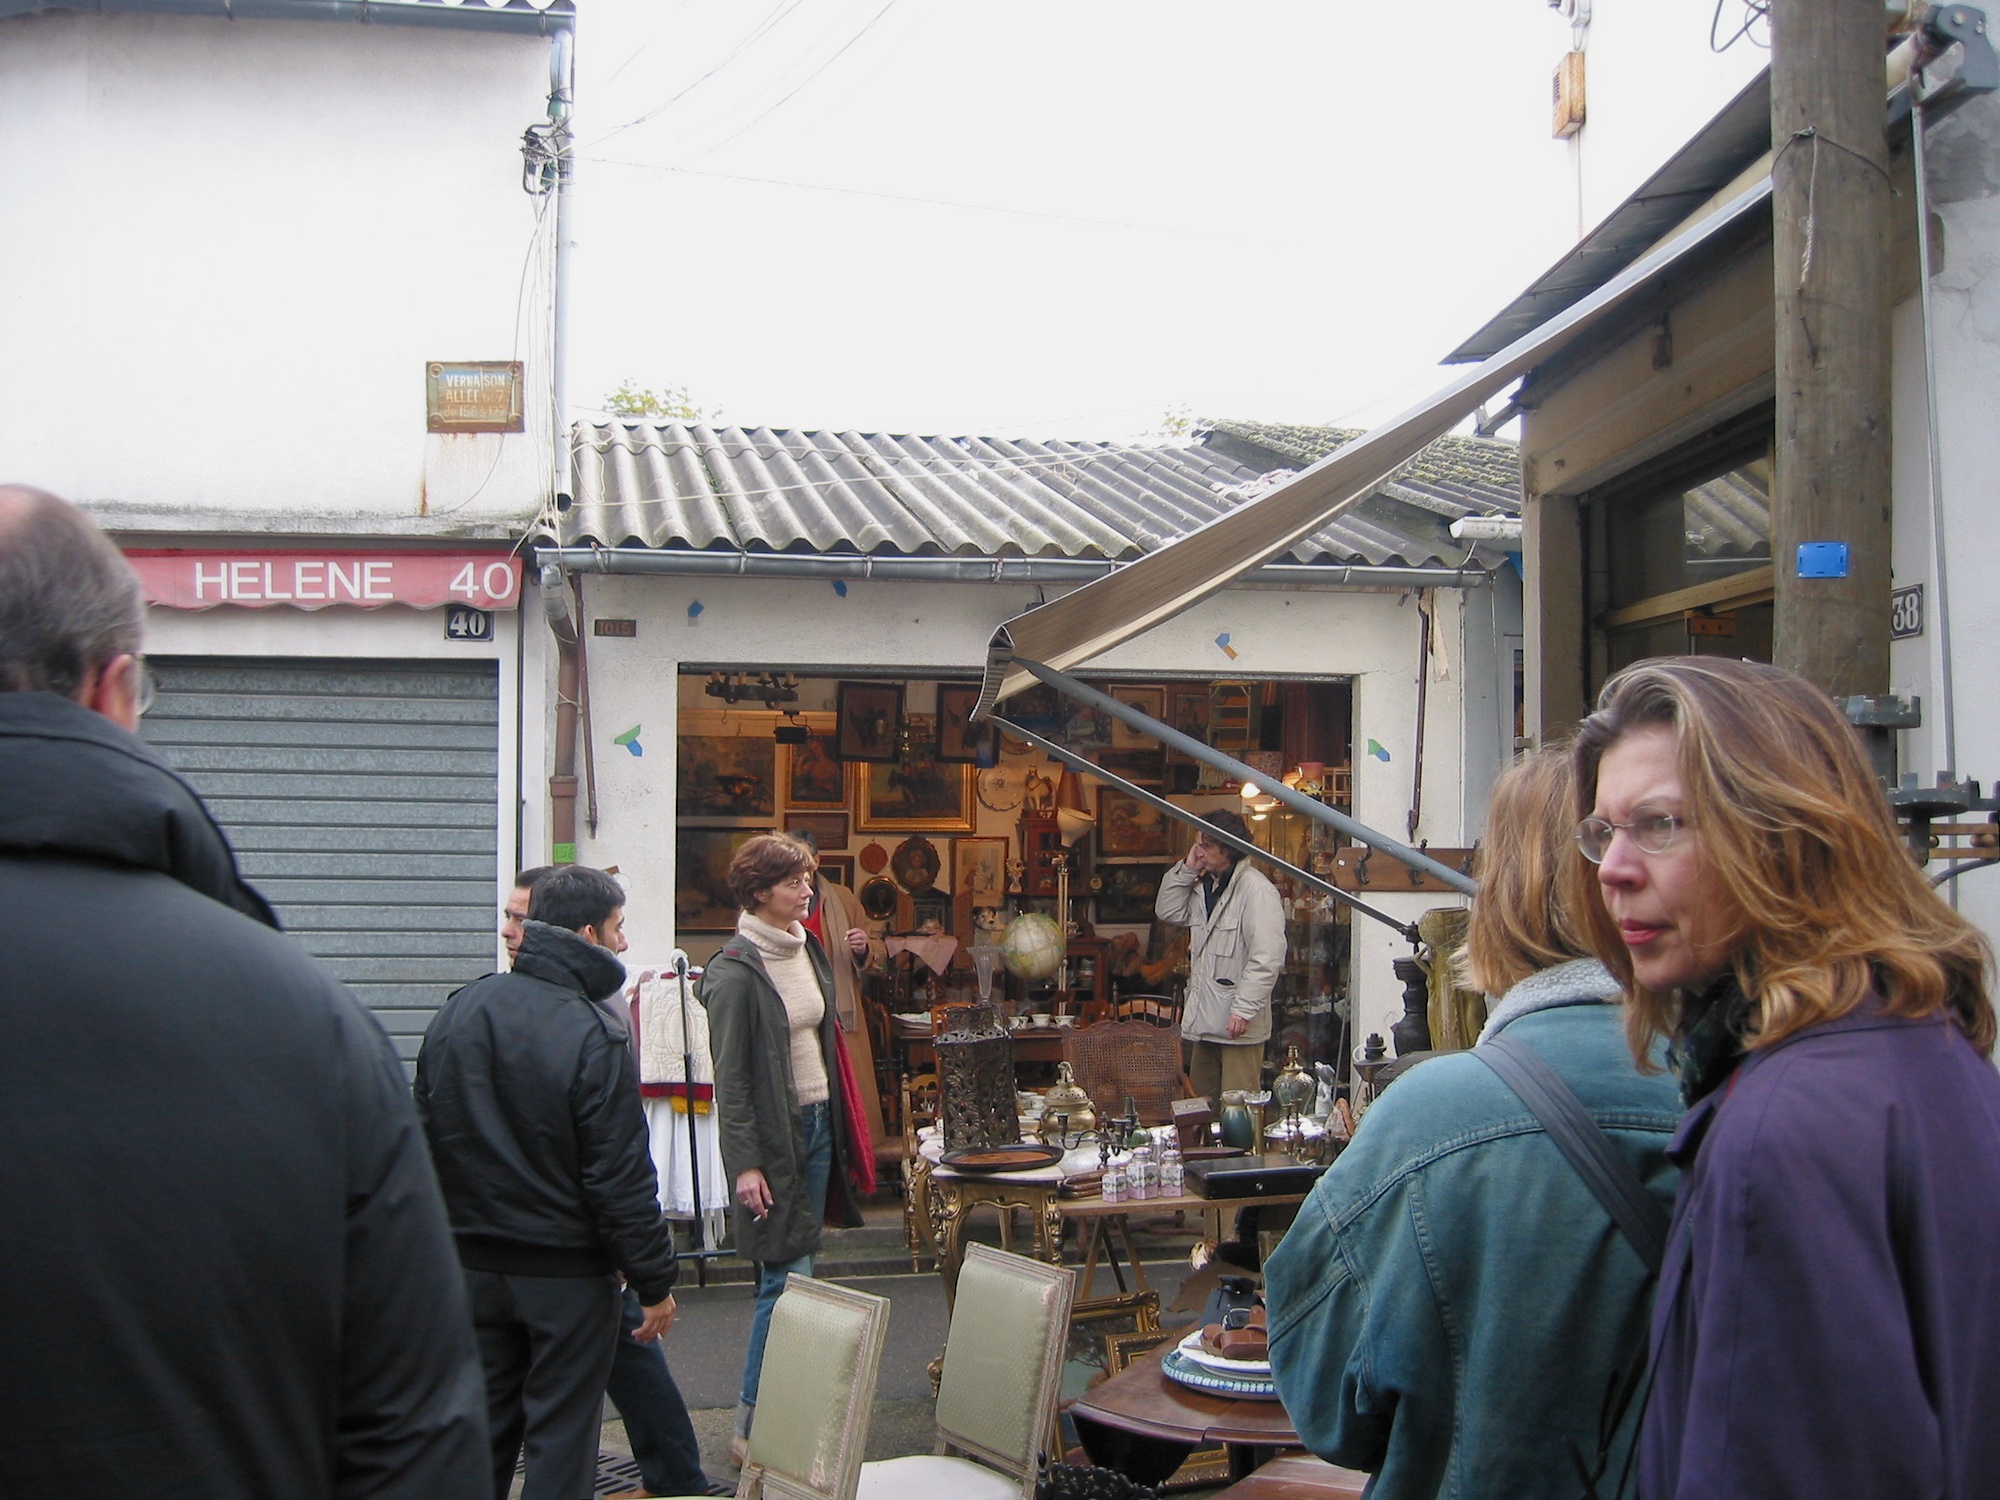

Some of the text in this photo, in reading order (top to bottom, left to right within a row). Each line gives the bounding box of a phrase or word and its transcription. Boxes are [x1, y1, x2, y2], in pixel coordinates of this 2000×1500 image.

[446, 374, 505, 387] VERNAISON
[195, 561, 514, 600] HELENE 40
[450, 611, 486, 636] 40
[1892, 593, 1918, 631] 38
